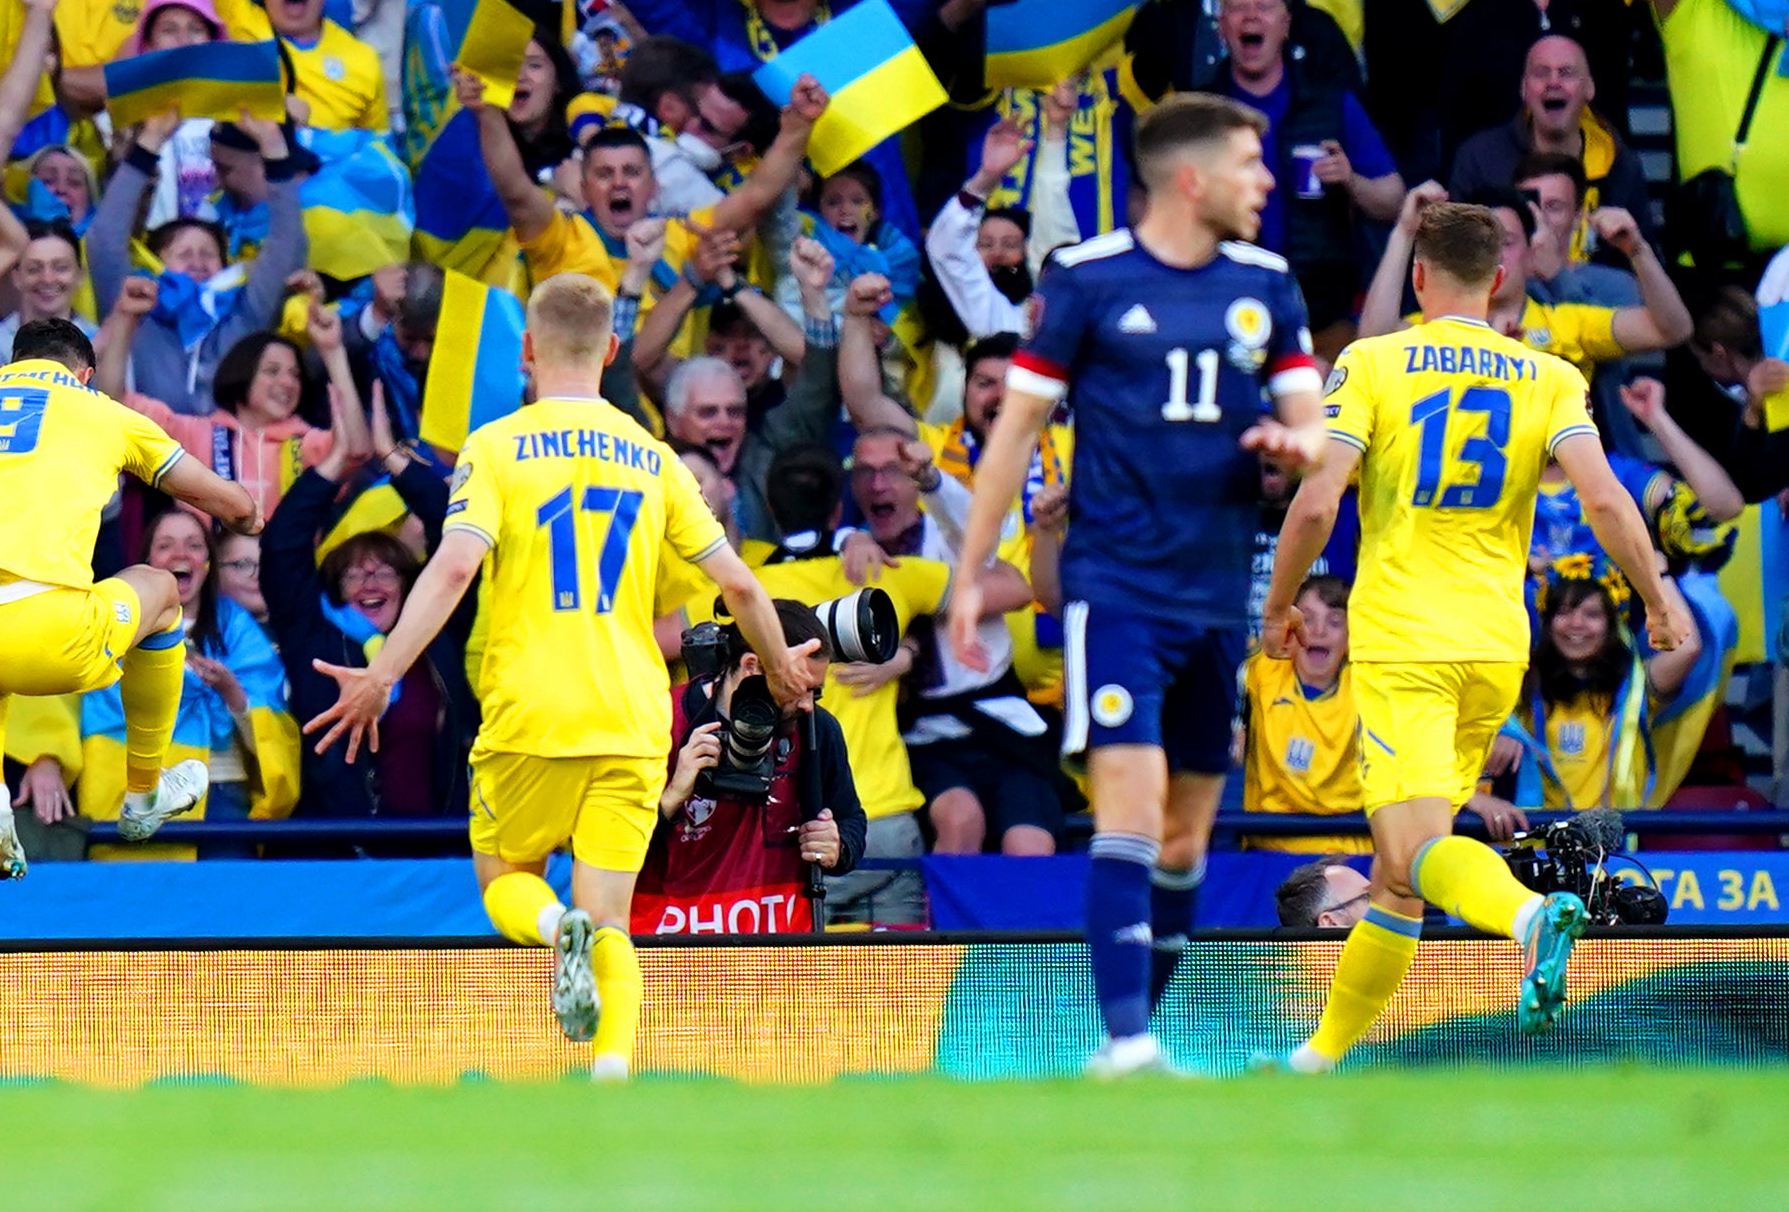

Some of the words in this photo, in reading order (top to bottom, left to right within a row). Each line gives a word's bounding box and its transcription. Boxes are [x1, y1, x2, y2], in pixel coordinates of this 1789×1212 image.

[1161, 347, 1223, 423] 11
[1403, 345, 1538, 381] ZABARNYI
[513, 429, 662, 476] ZINCHENKO
[1409, 386, 1512, 509] 13
[535, 483, 645, 615] 17
